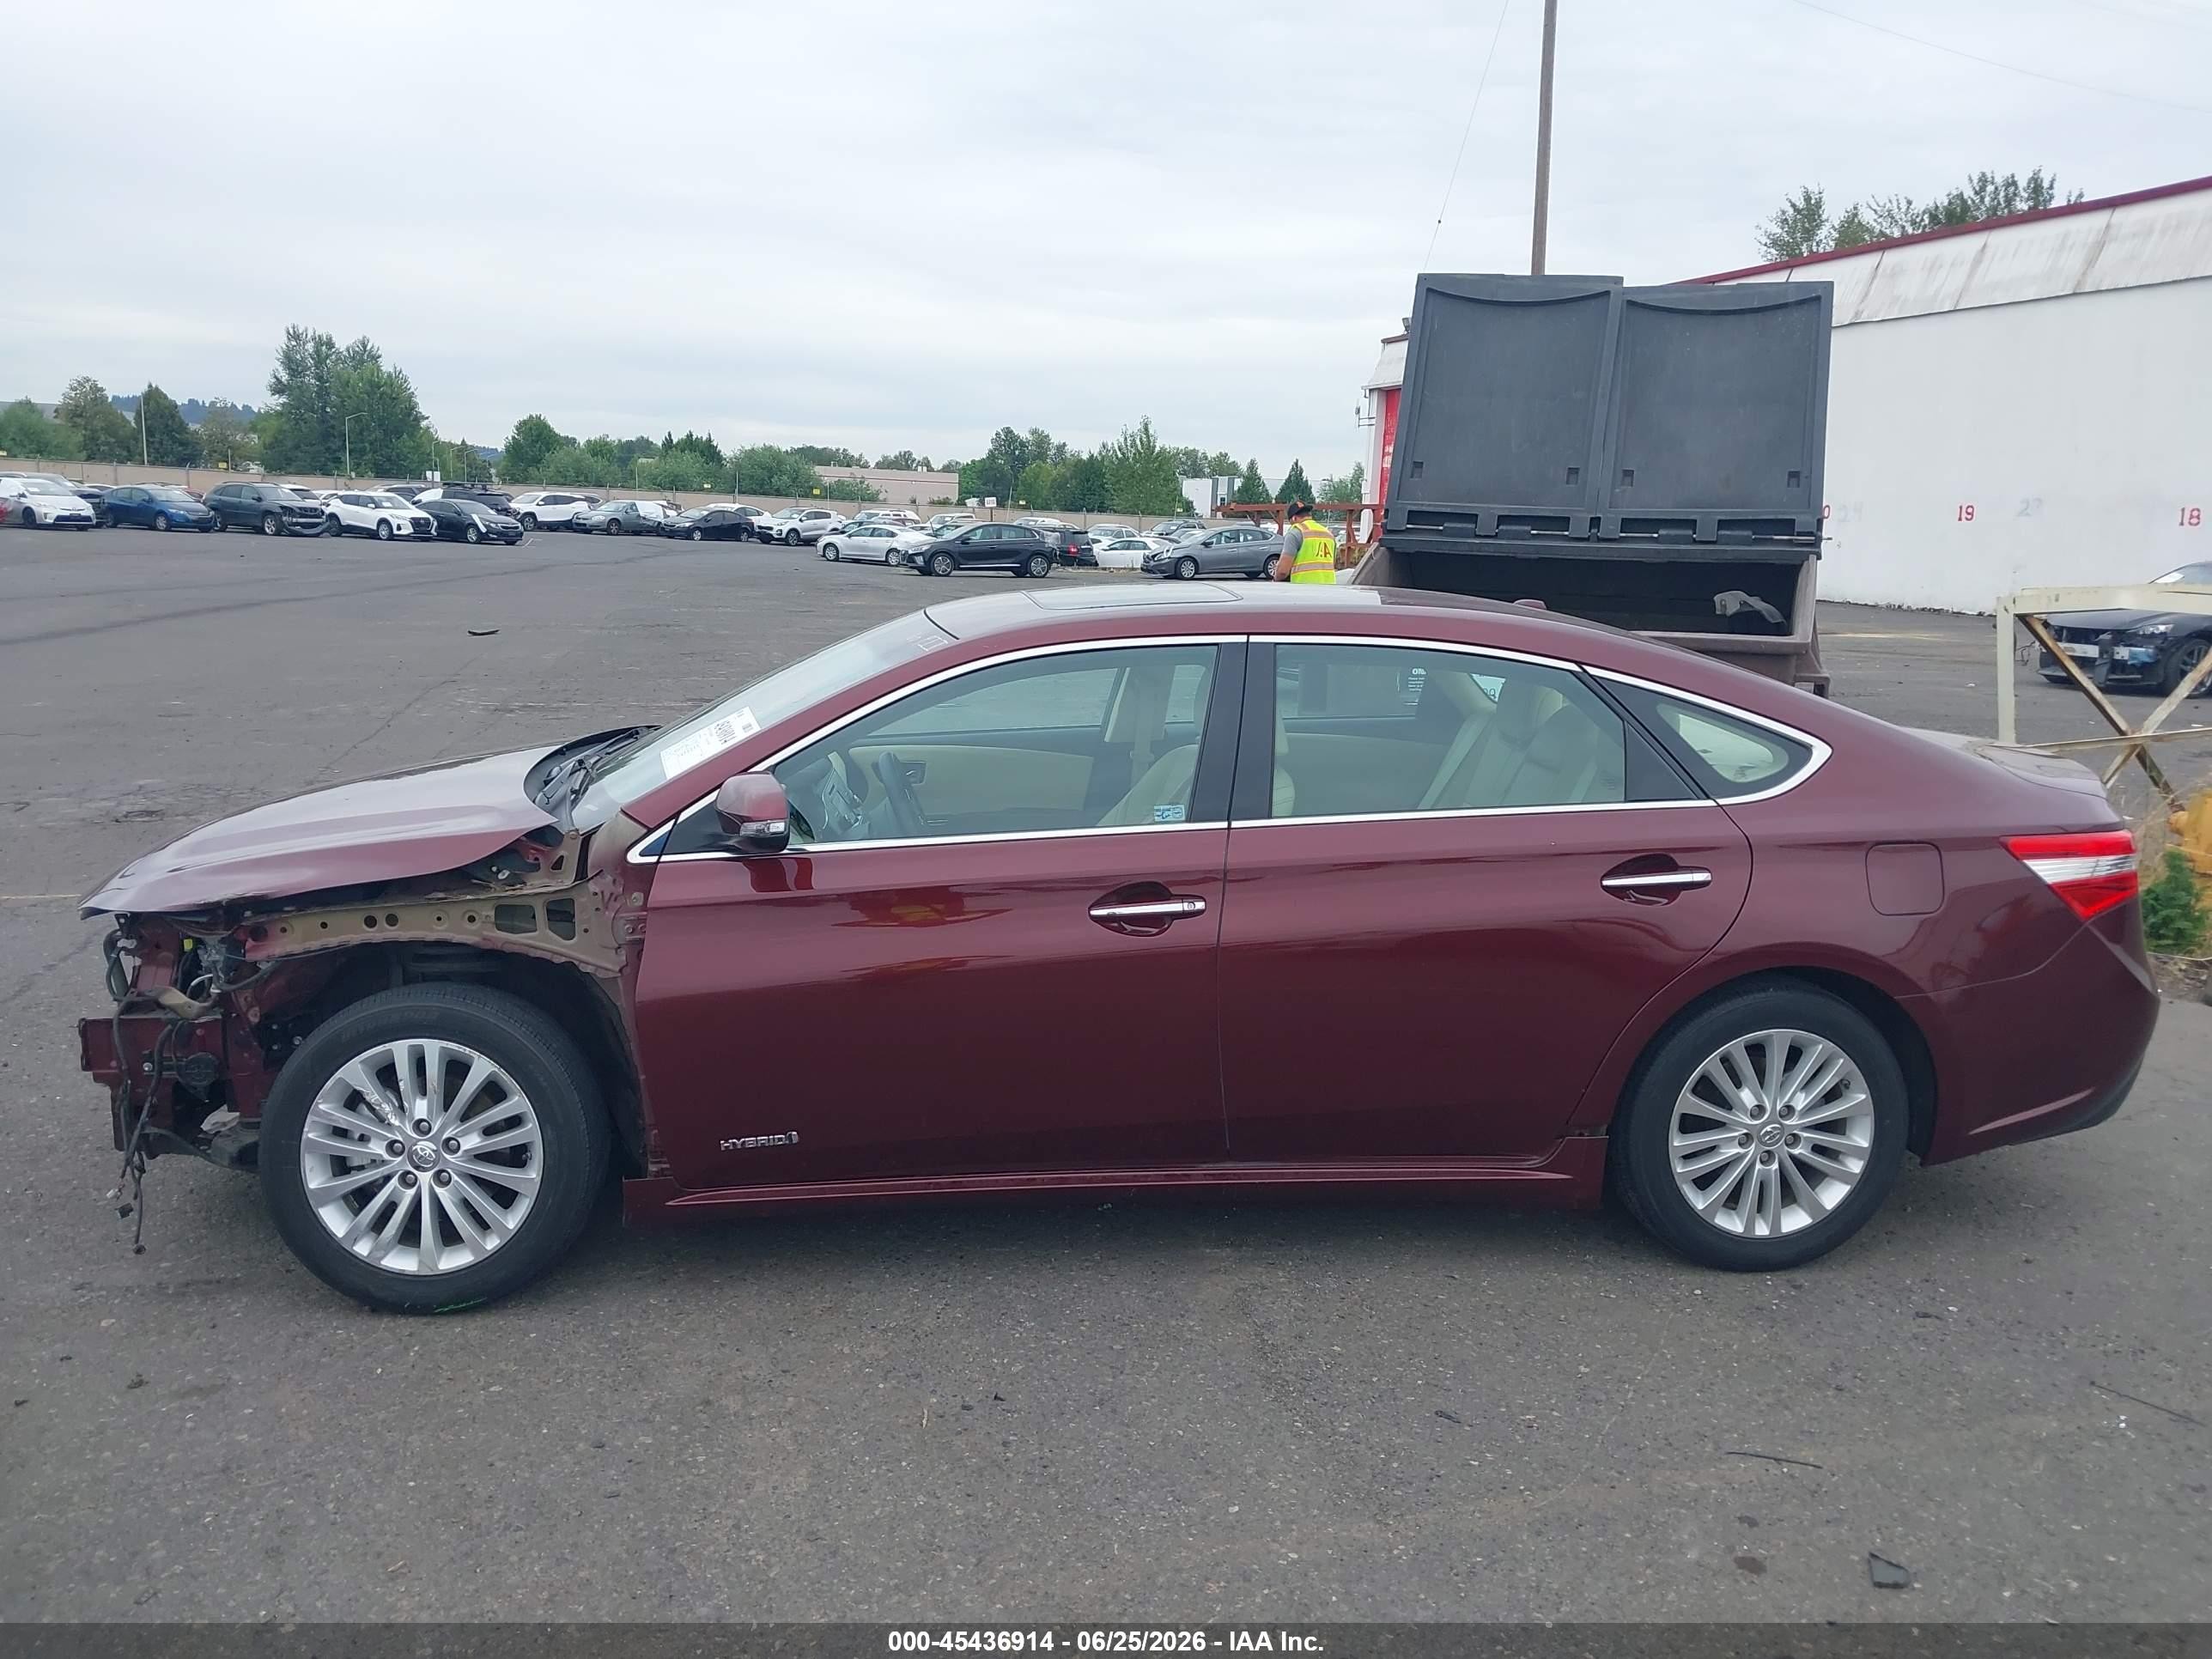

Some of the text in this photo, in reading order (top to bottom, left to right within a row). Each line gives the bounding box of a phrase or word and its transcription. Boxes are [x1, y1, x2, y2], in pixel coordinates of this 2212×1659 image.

[1958, 505, 1974, 521] 19
[2179, 507, 2201, 526] 18
[720, 1134, 786, 1151] HYBRID
